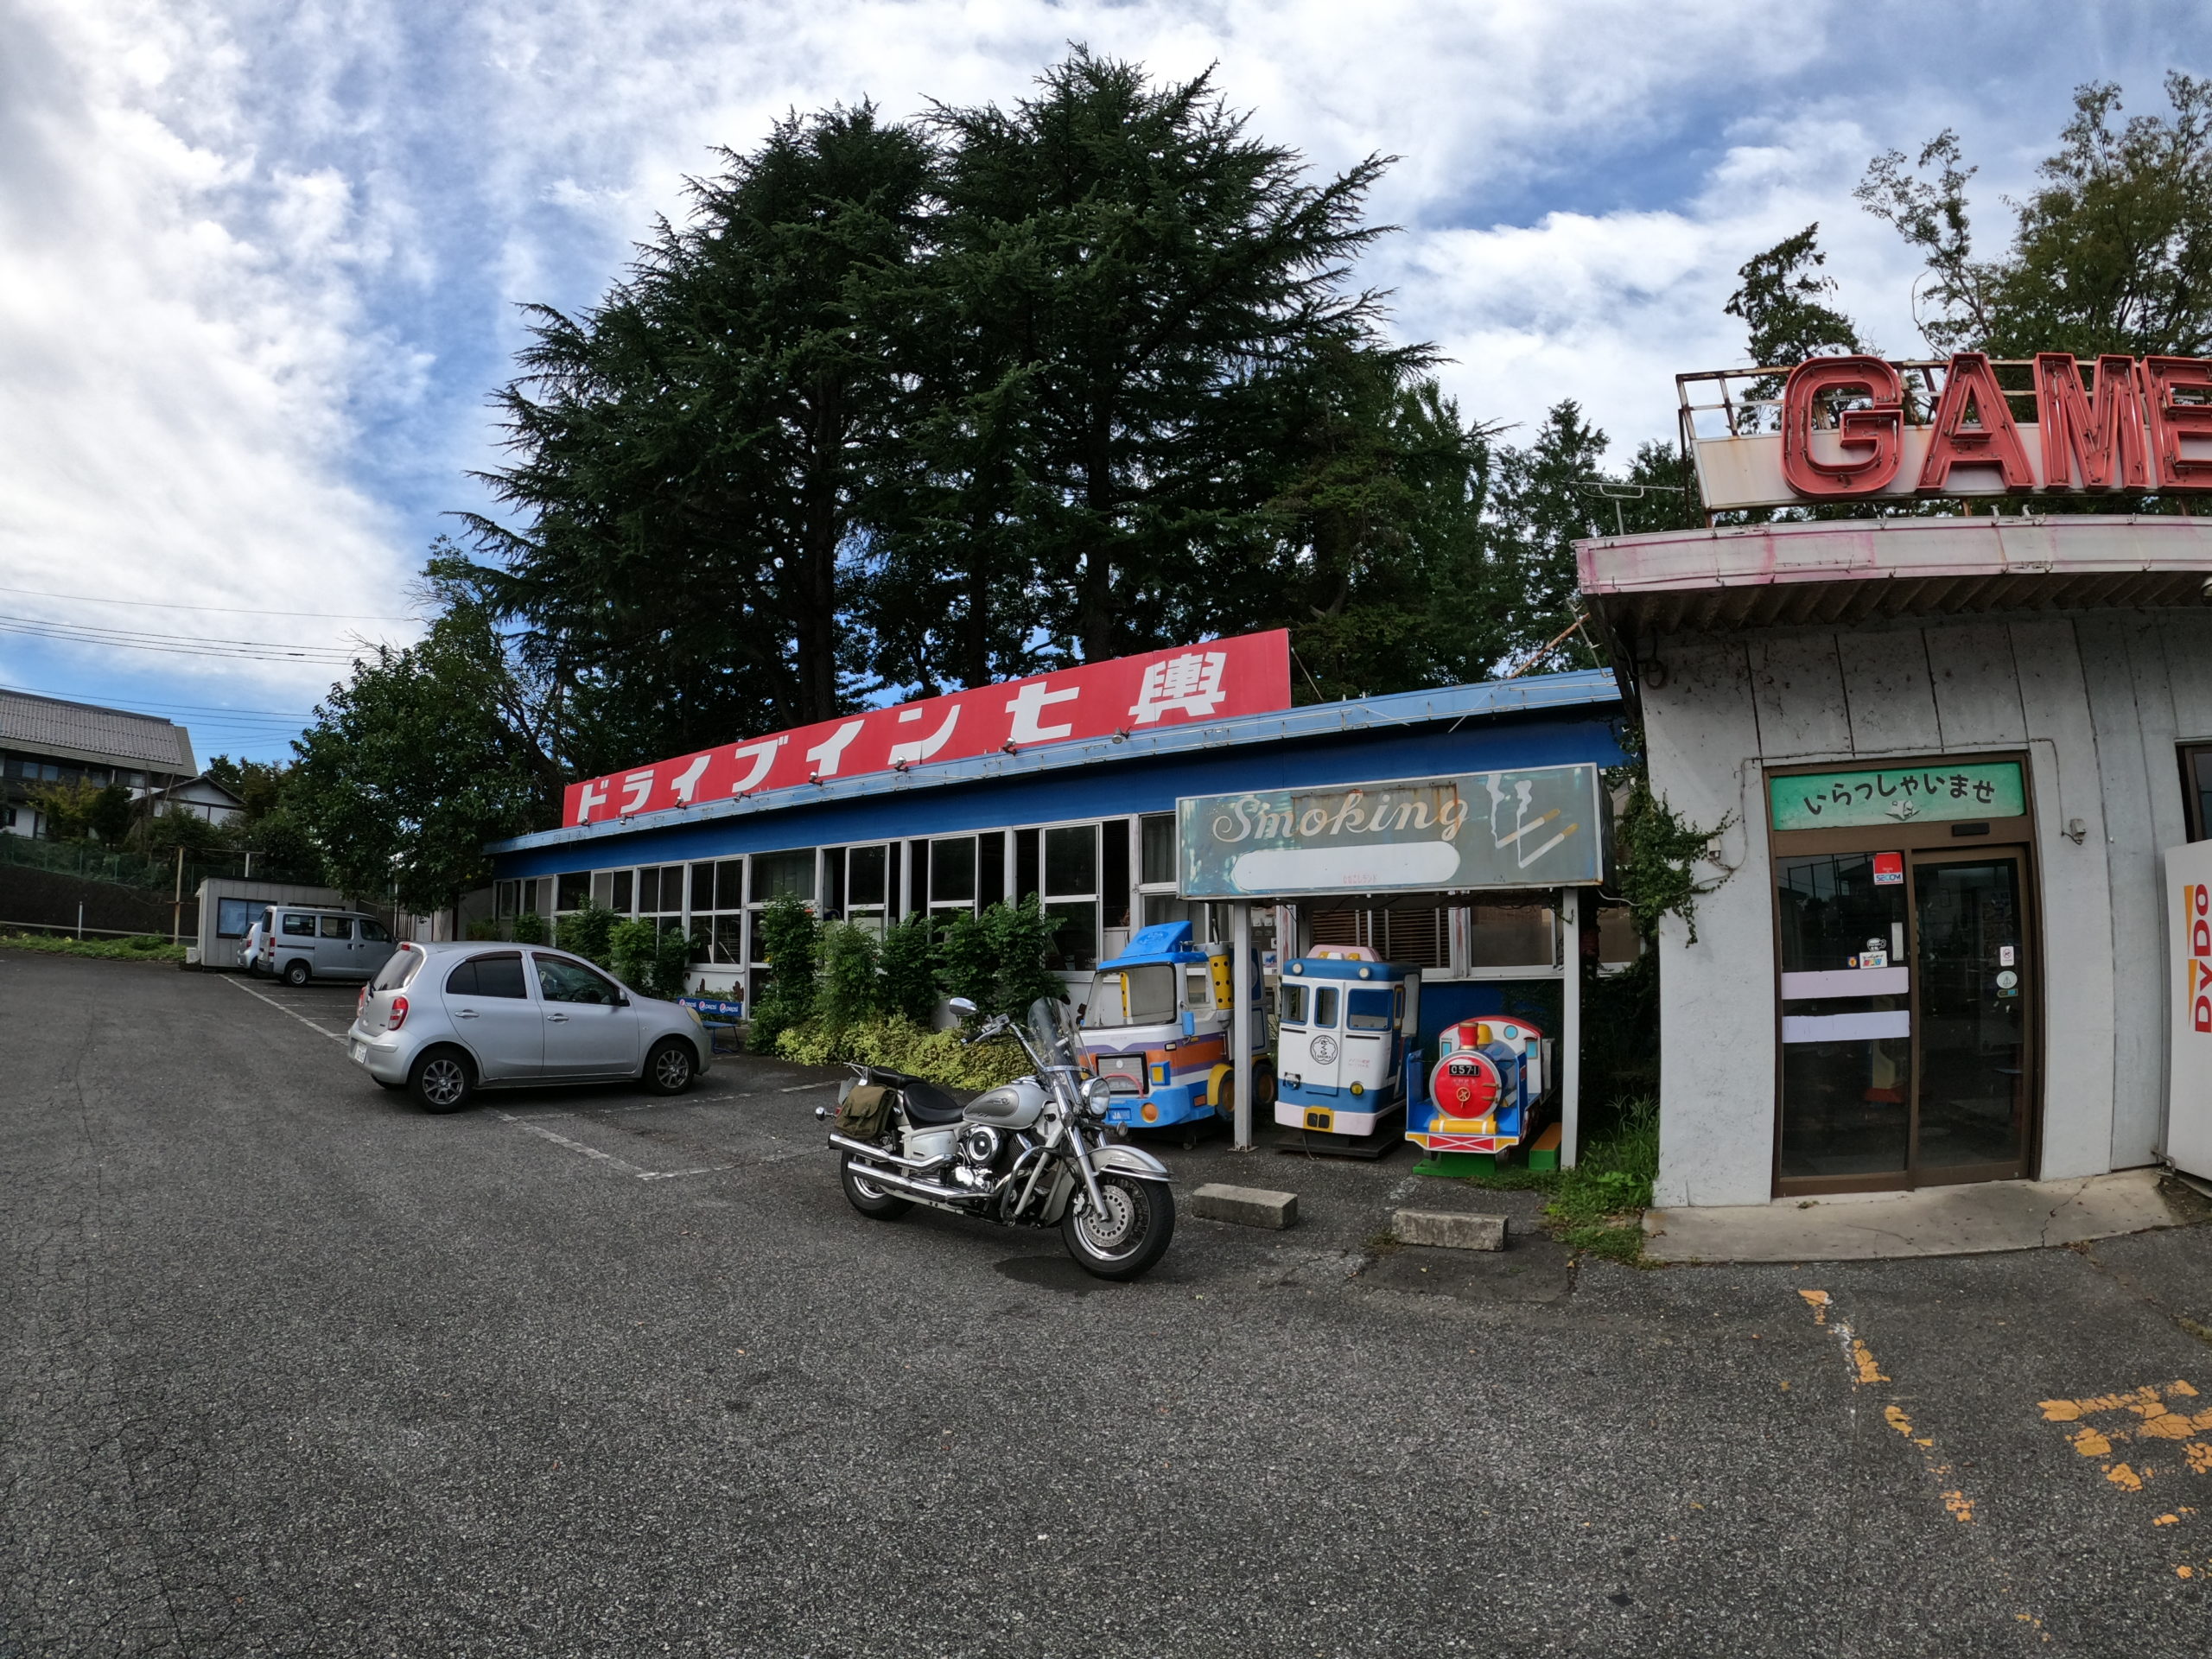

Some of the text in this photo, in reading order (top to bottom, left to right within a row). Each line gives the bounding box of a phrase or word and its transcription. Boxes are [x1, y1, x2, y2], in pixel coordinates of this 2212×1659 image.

[1781, 352, 2212, 497] GAME
[1212, 791, 1468, 843] Smoking
[1803, 773, 1995, 815] いらっしゃいませ
[2192, 883, 2212, 1033] DYDO
